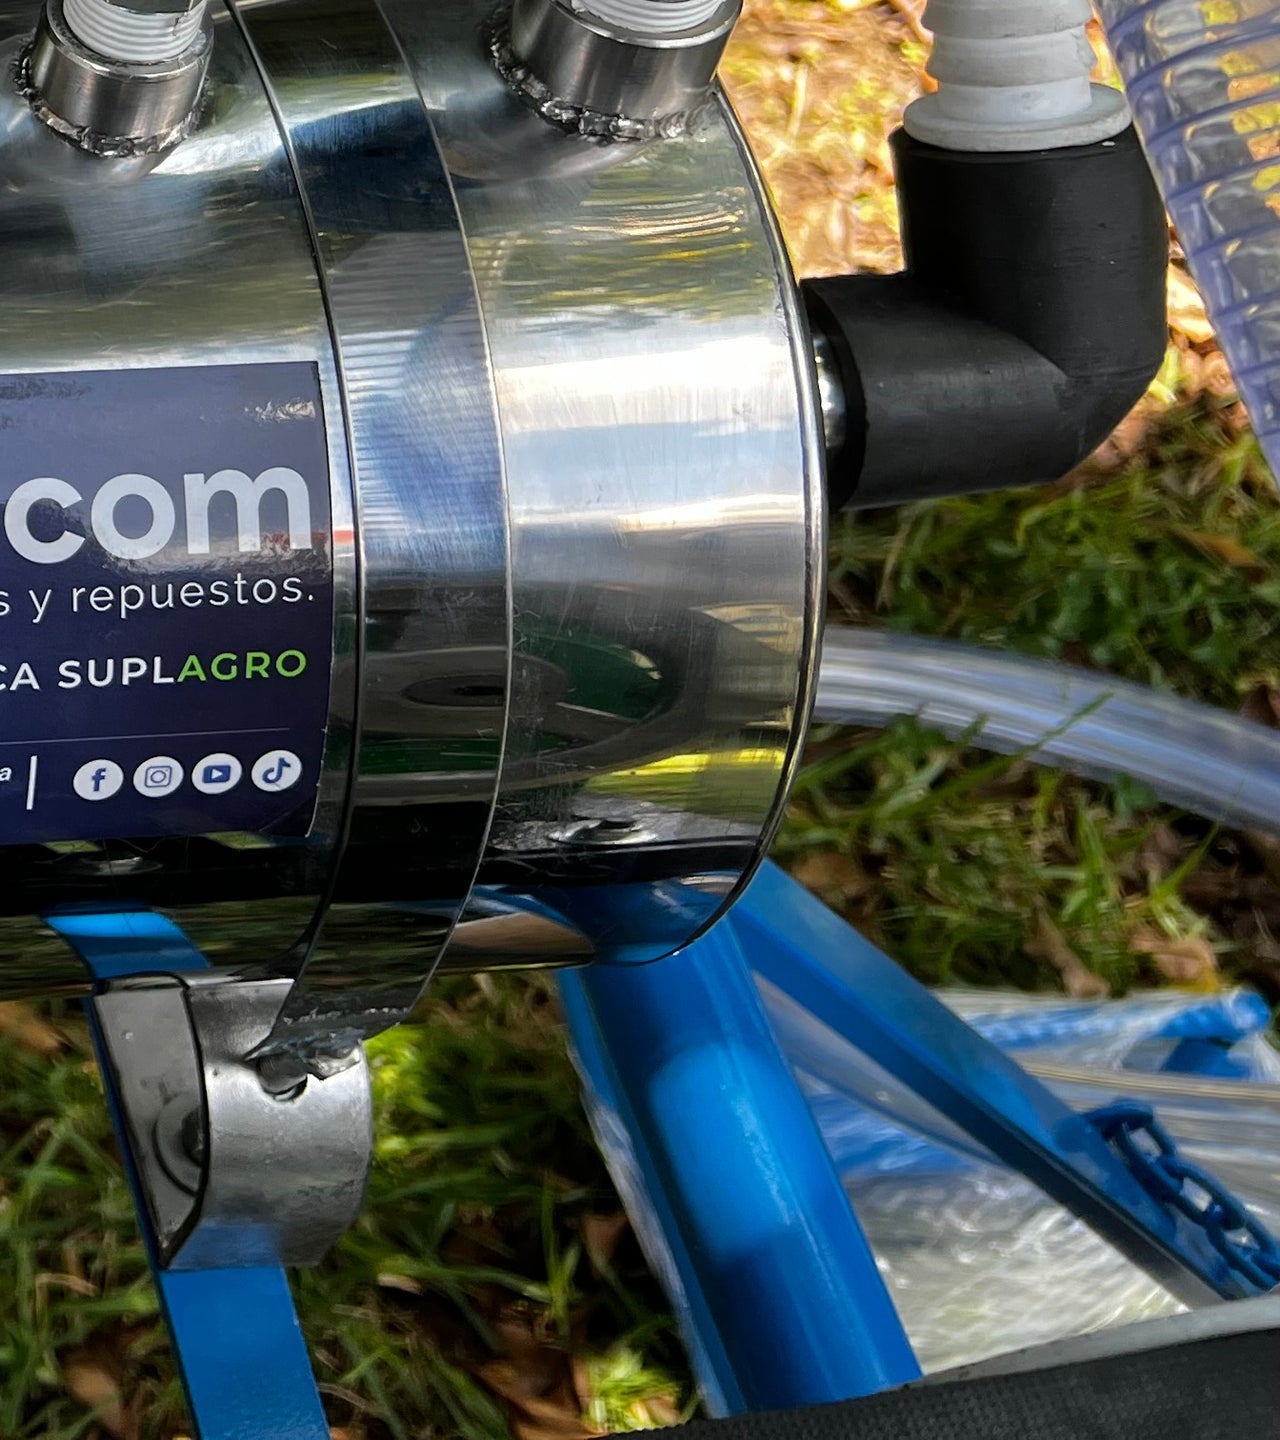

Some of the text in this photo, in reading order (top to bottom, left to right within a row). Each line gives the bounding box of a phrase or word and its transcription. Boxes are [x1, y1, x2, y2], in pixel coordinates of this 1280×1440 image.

[28, 588, 52, 624] y
[71, 572, 315, 620] repuestos.
[57, 648, 308, 689] SUPLAGRO
